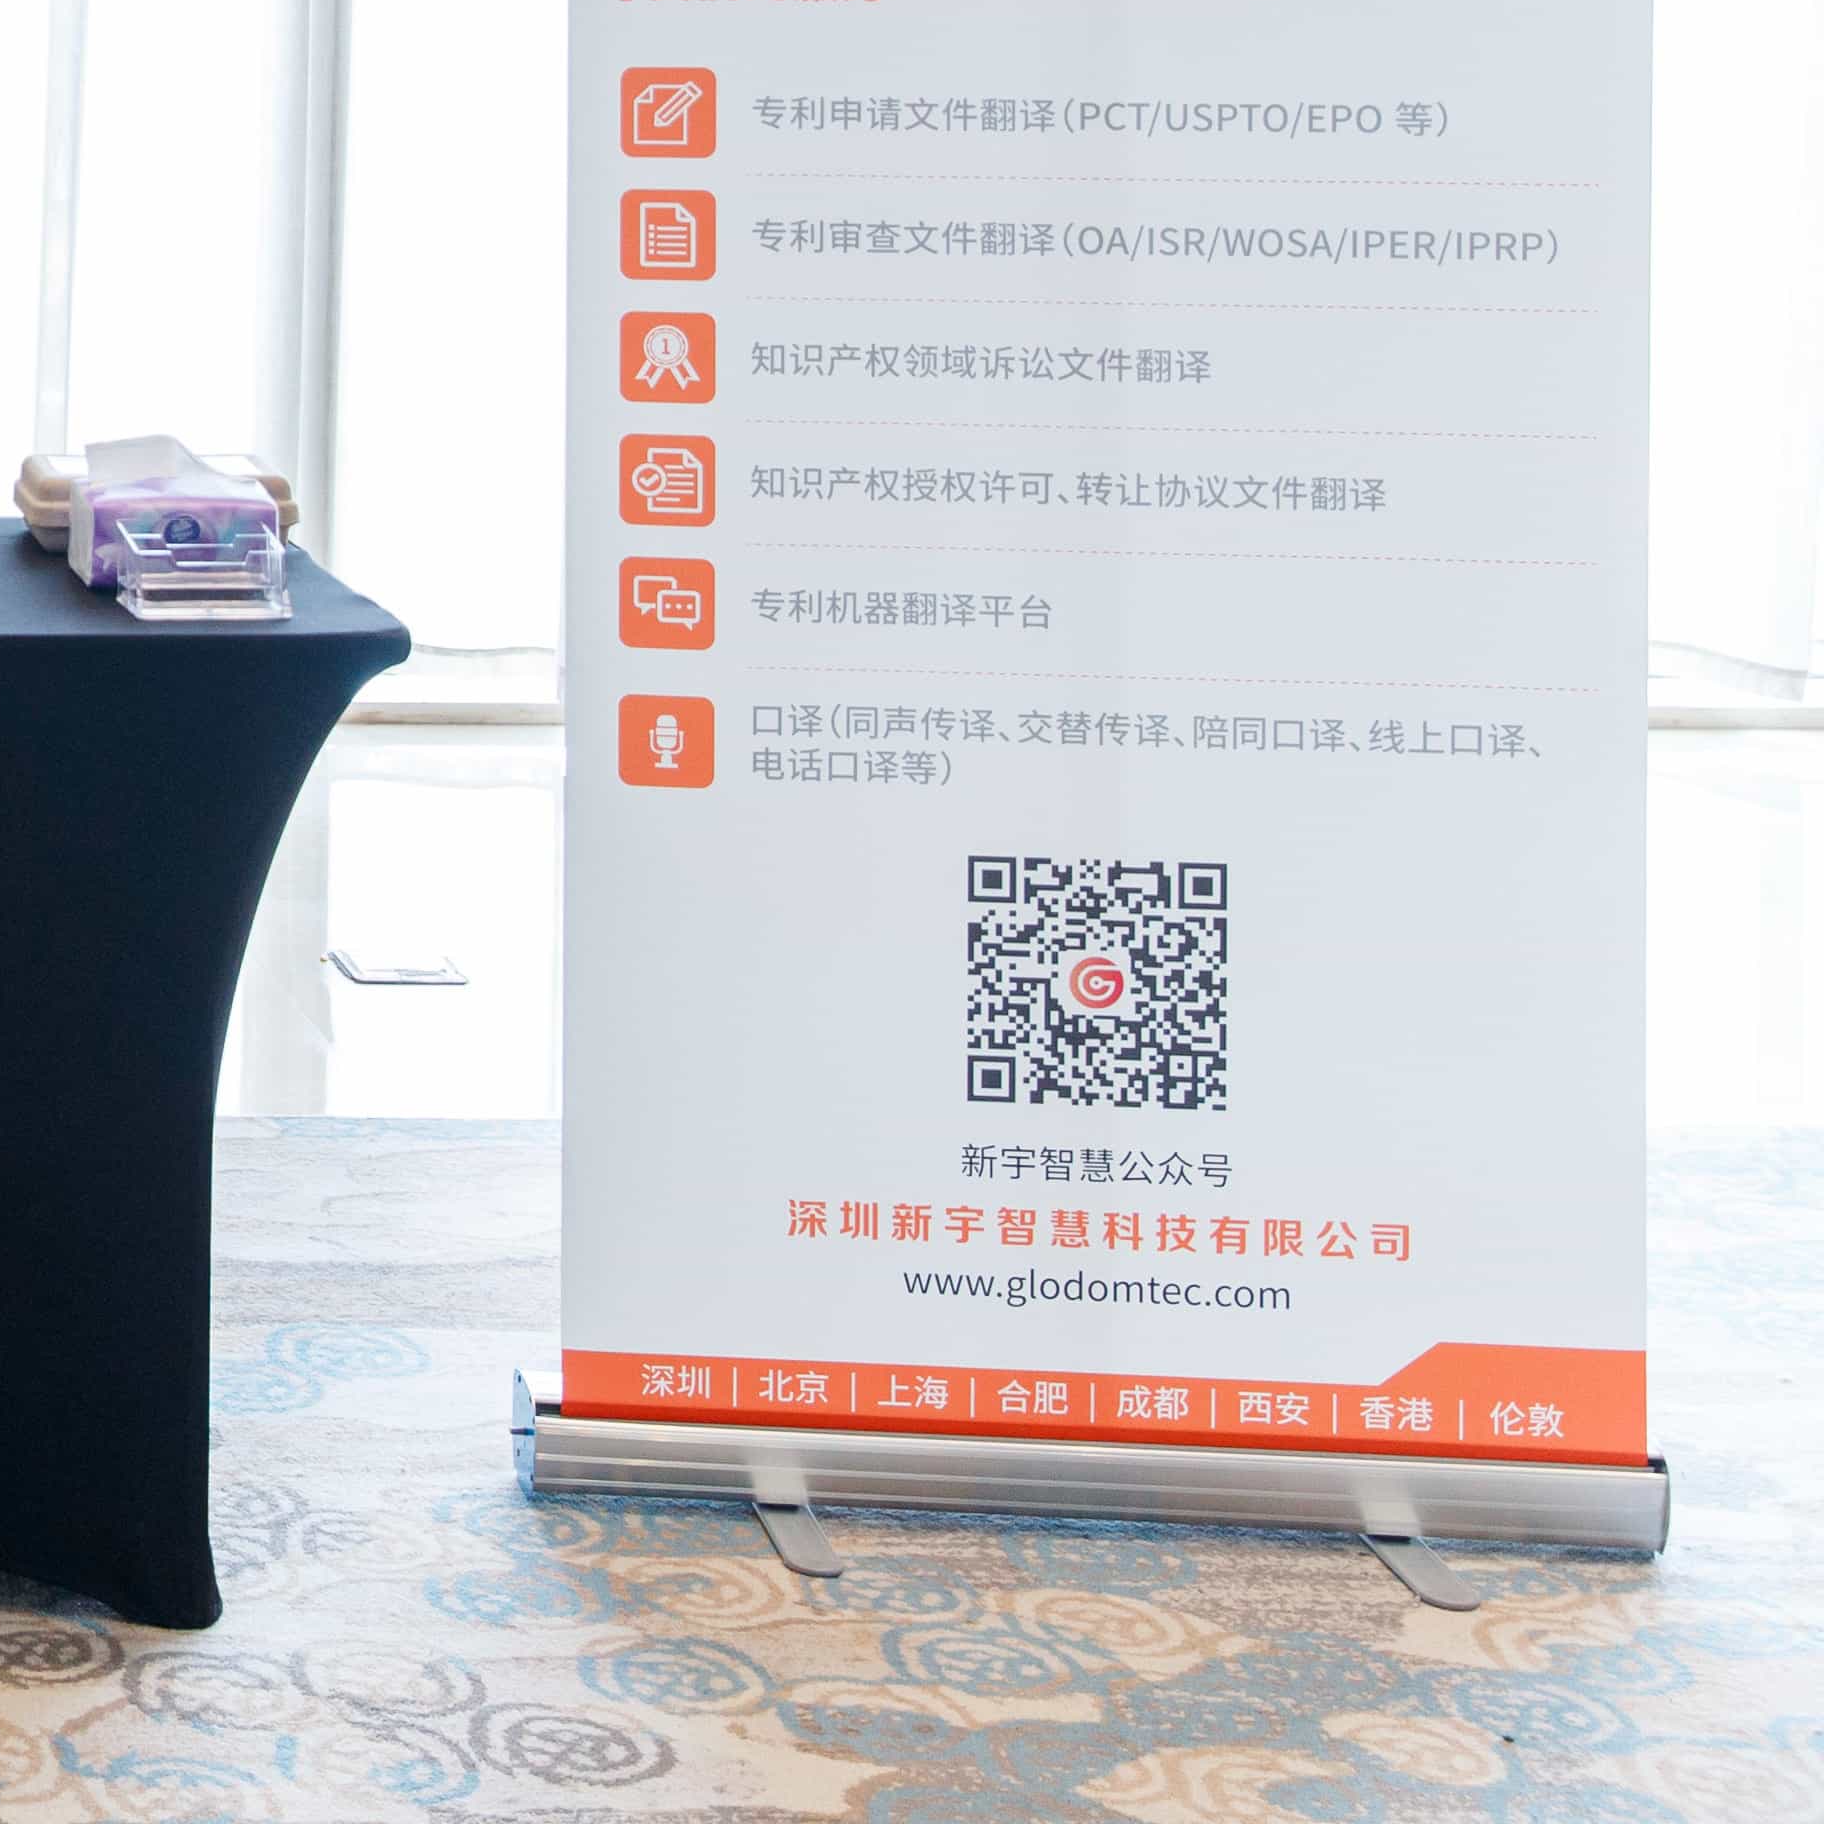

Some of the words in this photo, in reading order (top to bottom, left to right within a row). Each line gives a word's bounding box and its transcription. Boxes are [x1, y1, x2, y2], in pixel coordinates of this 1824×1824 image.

[751, 342, 1210, 385] 知识产权领域诉讼文件翻译
[751, 466, 1387, 513] 知识产权授权许可、转让协议文件翻译
[753, 590, 1053, 631] 专利机器翻译平台
[960, 1142, 1233, 1189] 新宇智慧公众号
[786, 1197, 1413, 1262] 深圳新宇智慧科技有限公司
[903, 1268, 1292, 1314] www.glodomtec.com
[641, 1361, 712, 1400] 深圳
[758, 1367, 830, 1406] 北京
[877, 1373, 950, 1412] 上海
[996, 1379, 1070, 1418] 合肥
[1116, 1384, 1190, 1423] 成都
[1238, 1390, 1311, 1429] 西安
[1359, 1395, 1434, 1435] 香港
[1489, 1400, 1565, 1441] 伦敦
